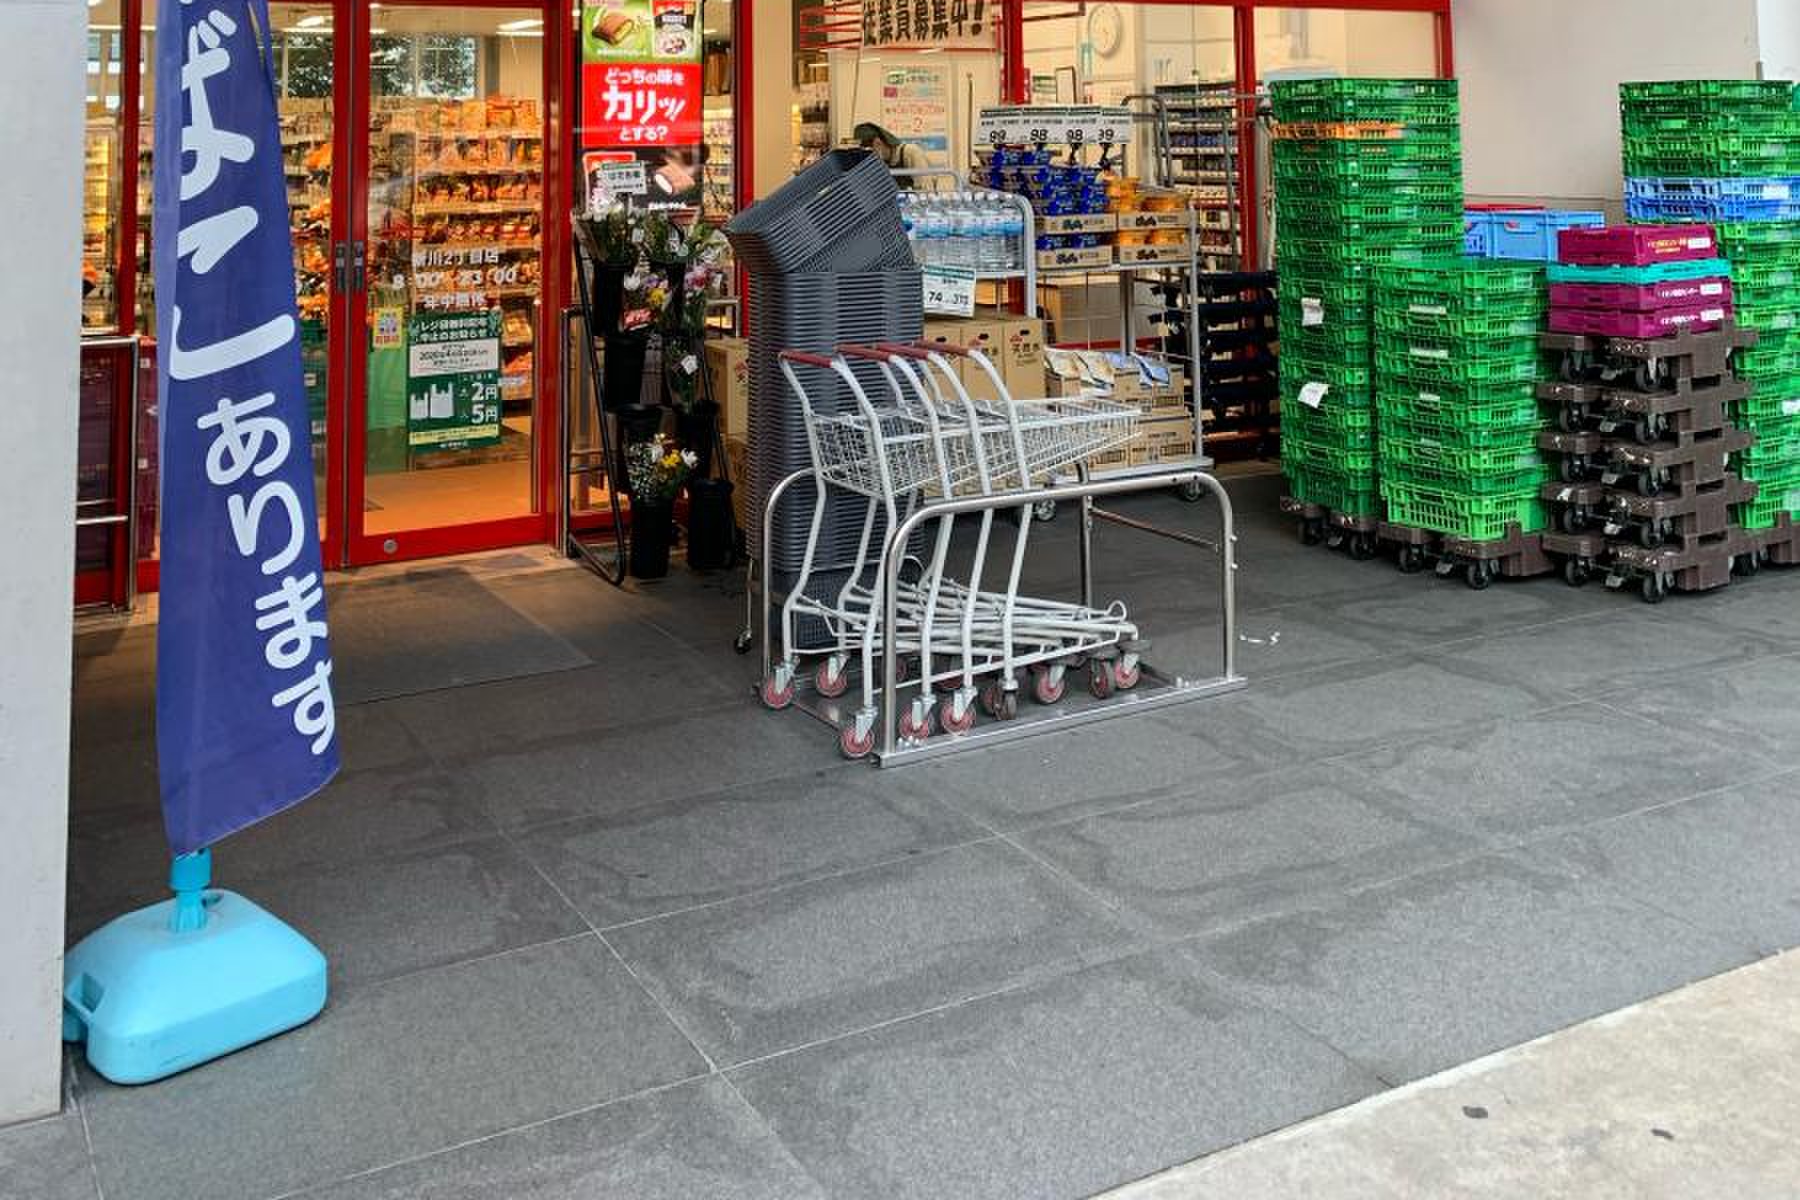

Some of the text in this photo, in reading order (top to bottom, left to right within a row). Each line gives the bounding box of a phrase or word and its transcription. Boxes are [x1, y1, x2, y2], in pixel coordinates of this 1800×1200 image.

[605, 67, 685, 86] どっちの味を
